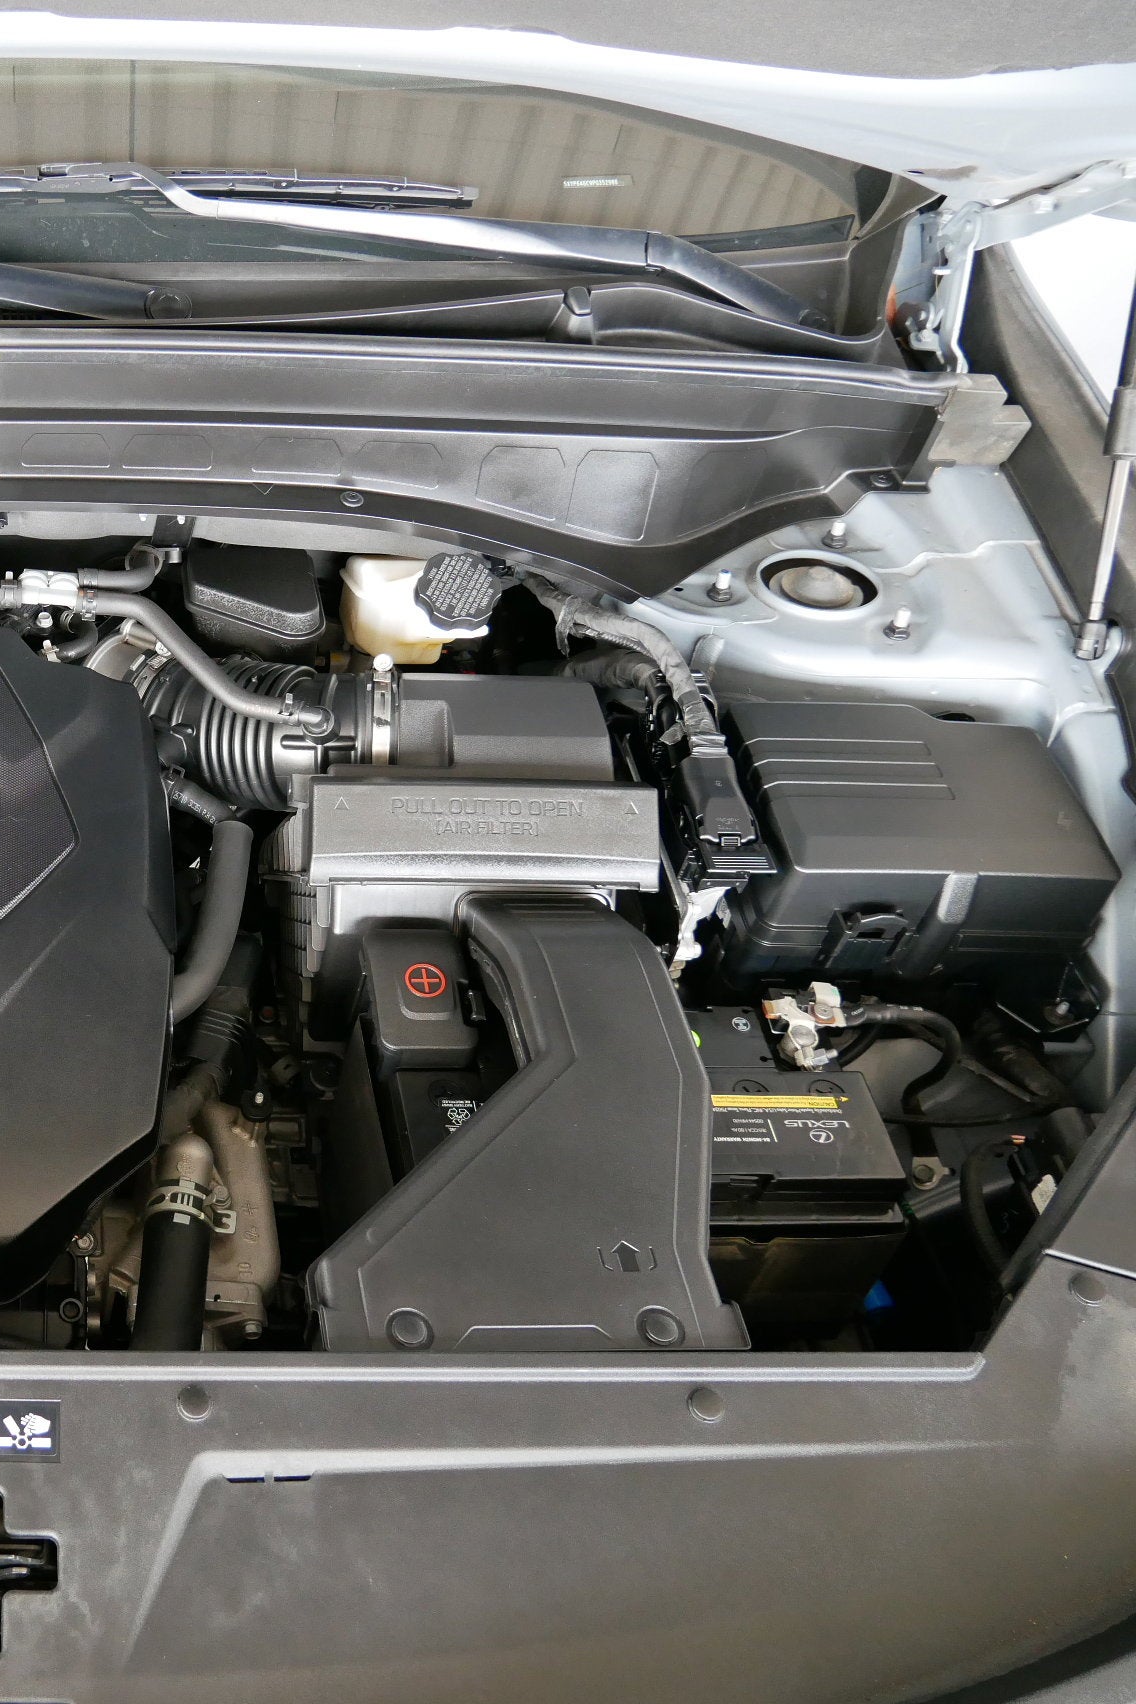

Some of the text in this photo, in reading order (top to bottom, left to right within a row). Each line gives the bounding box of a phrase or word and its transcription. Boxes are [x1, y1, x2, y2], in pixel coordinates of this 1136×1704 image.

[390, 797, 584, 817] PULL OUT TO OPEN
[783, 1119, 851, 1128] LEXUS
